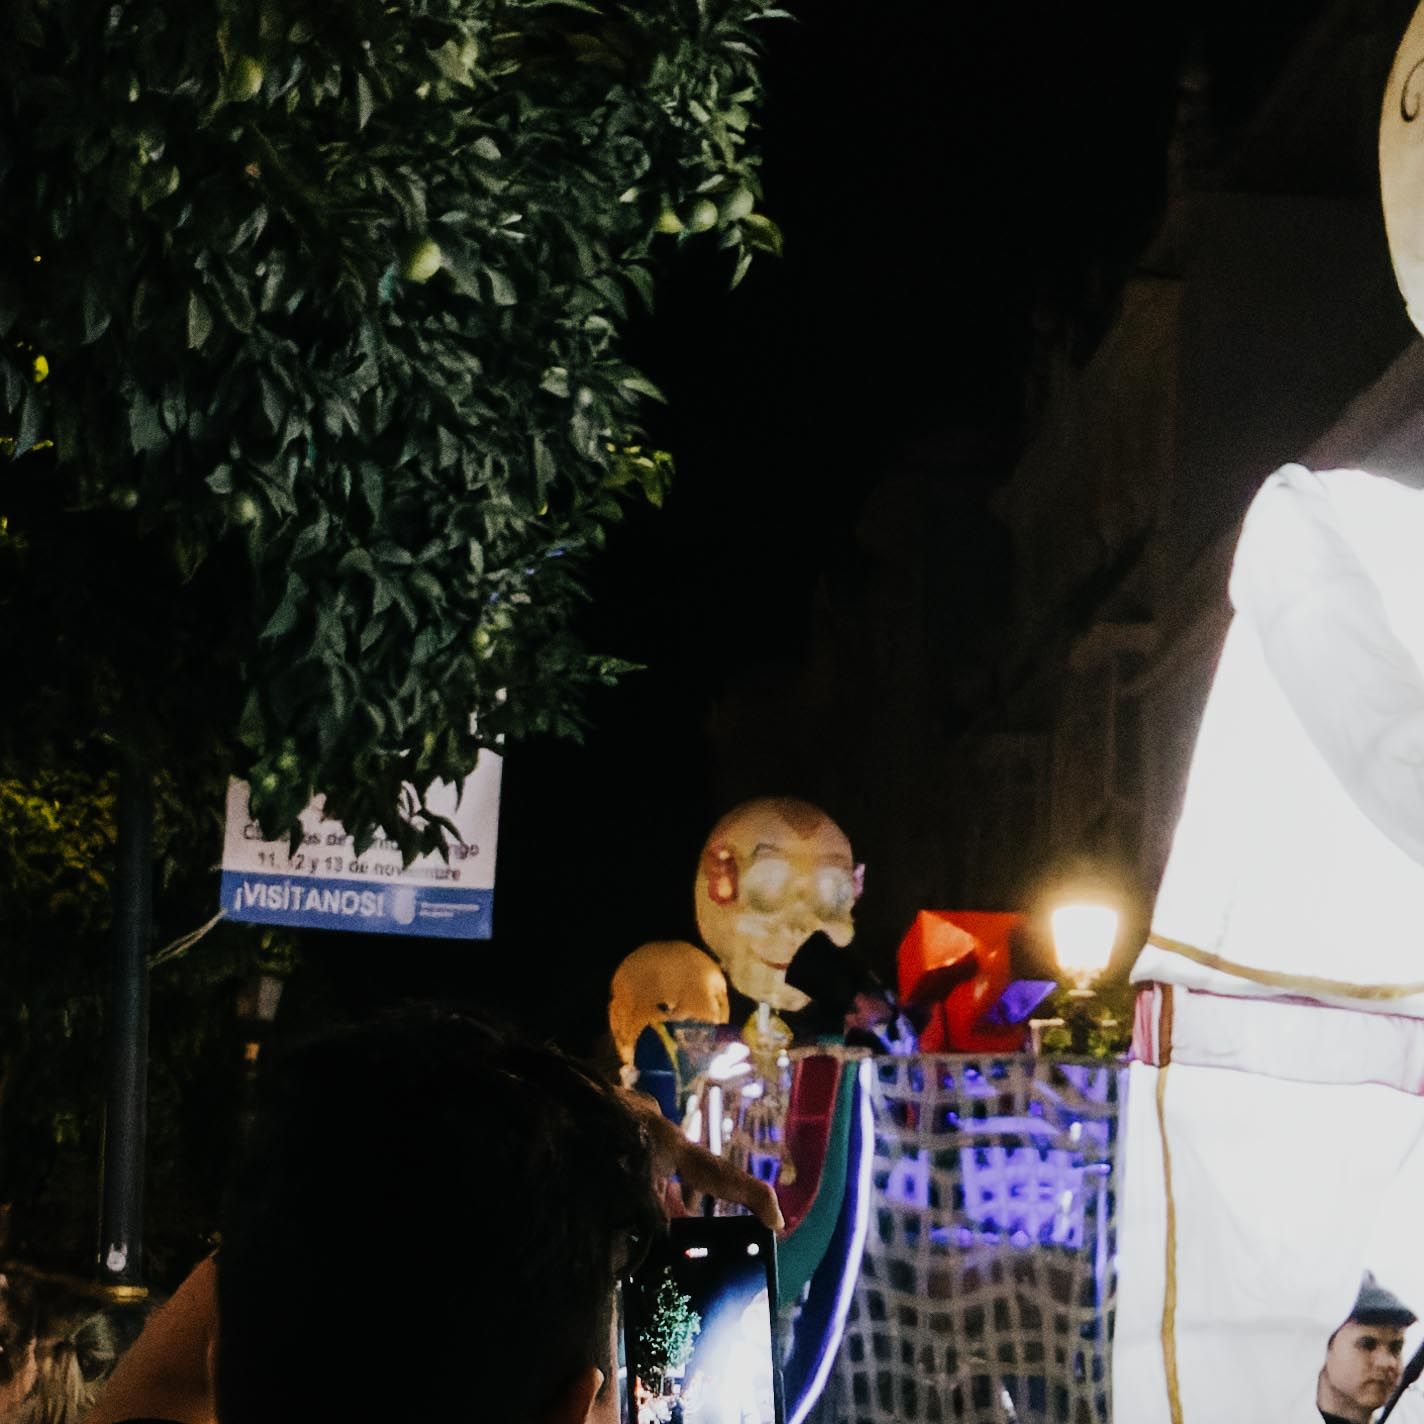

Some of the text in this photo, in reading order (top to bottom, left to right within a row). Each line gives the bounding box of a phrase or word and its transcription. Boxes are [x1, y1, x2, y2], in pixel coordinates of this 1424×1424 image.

[309, 858, 320, 875] y
[324, 855, 343, 872] 13
[234, 879, 385, 918] ¡VISÍTANOS!
